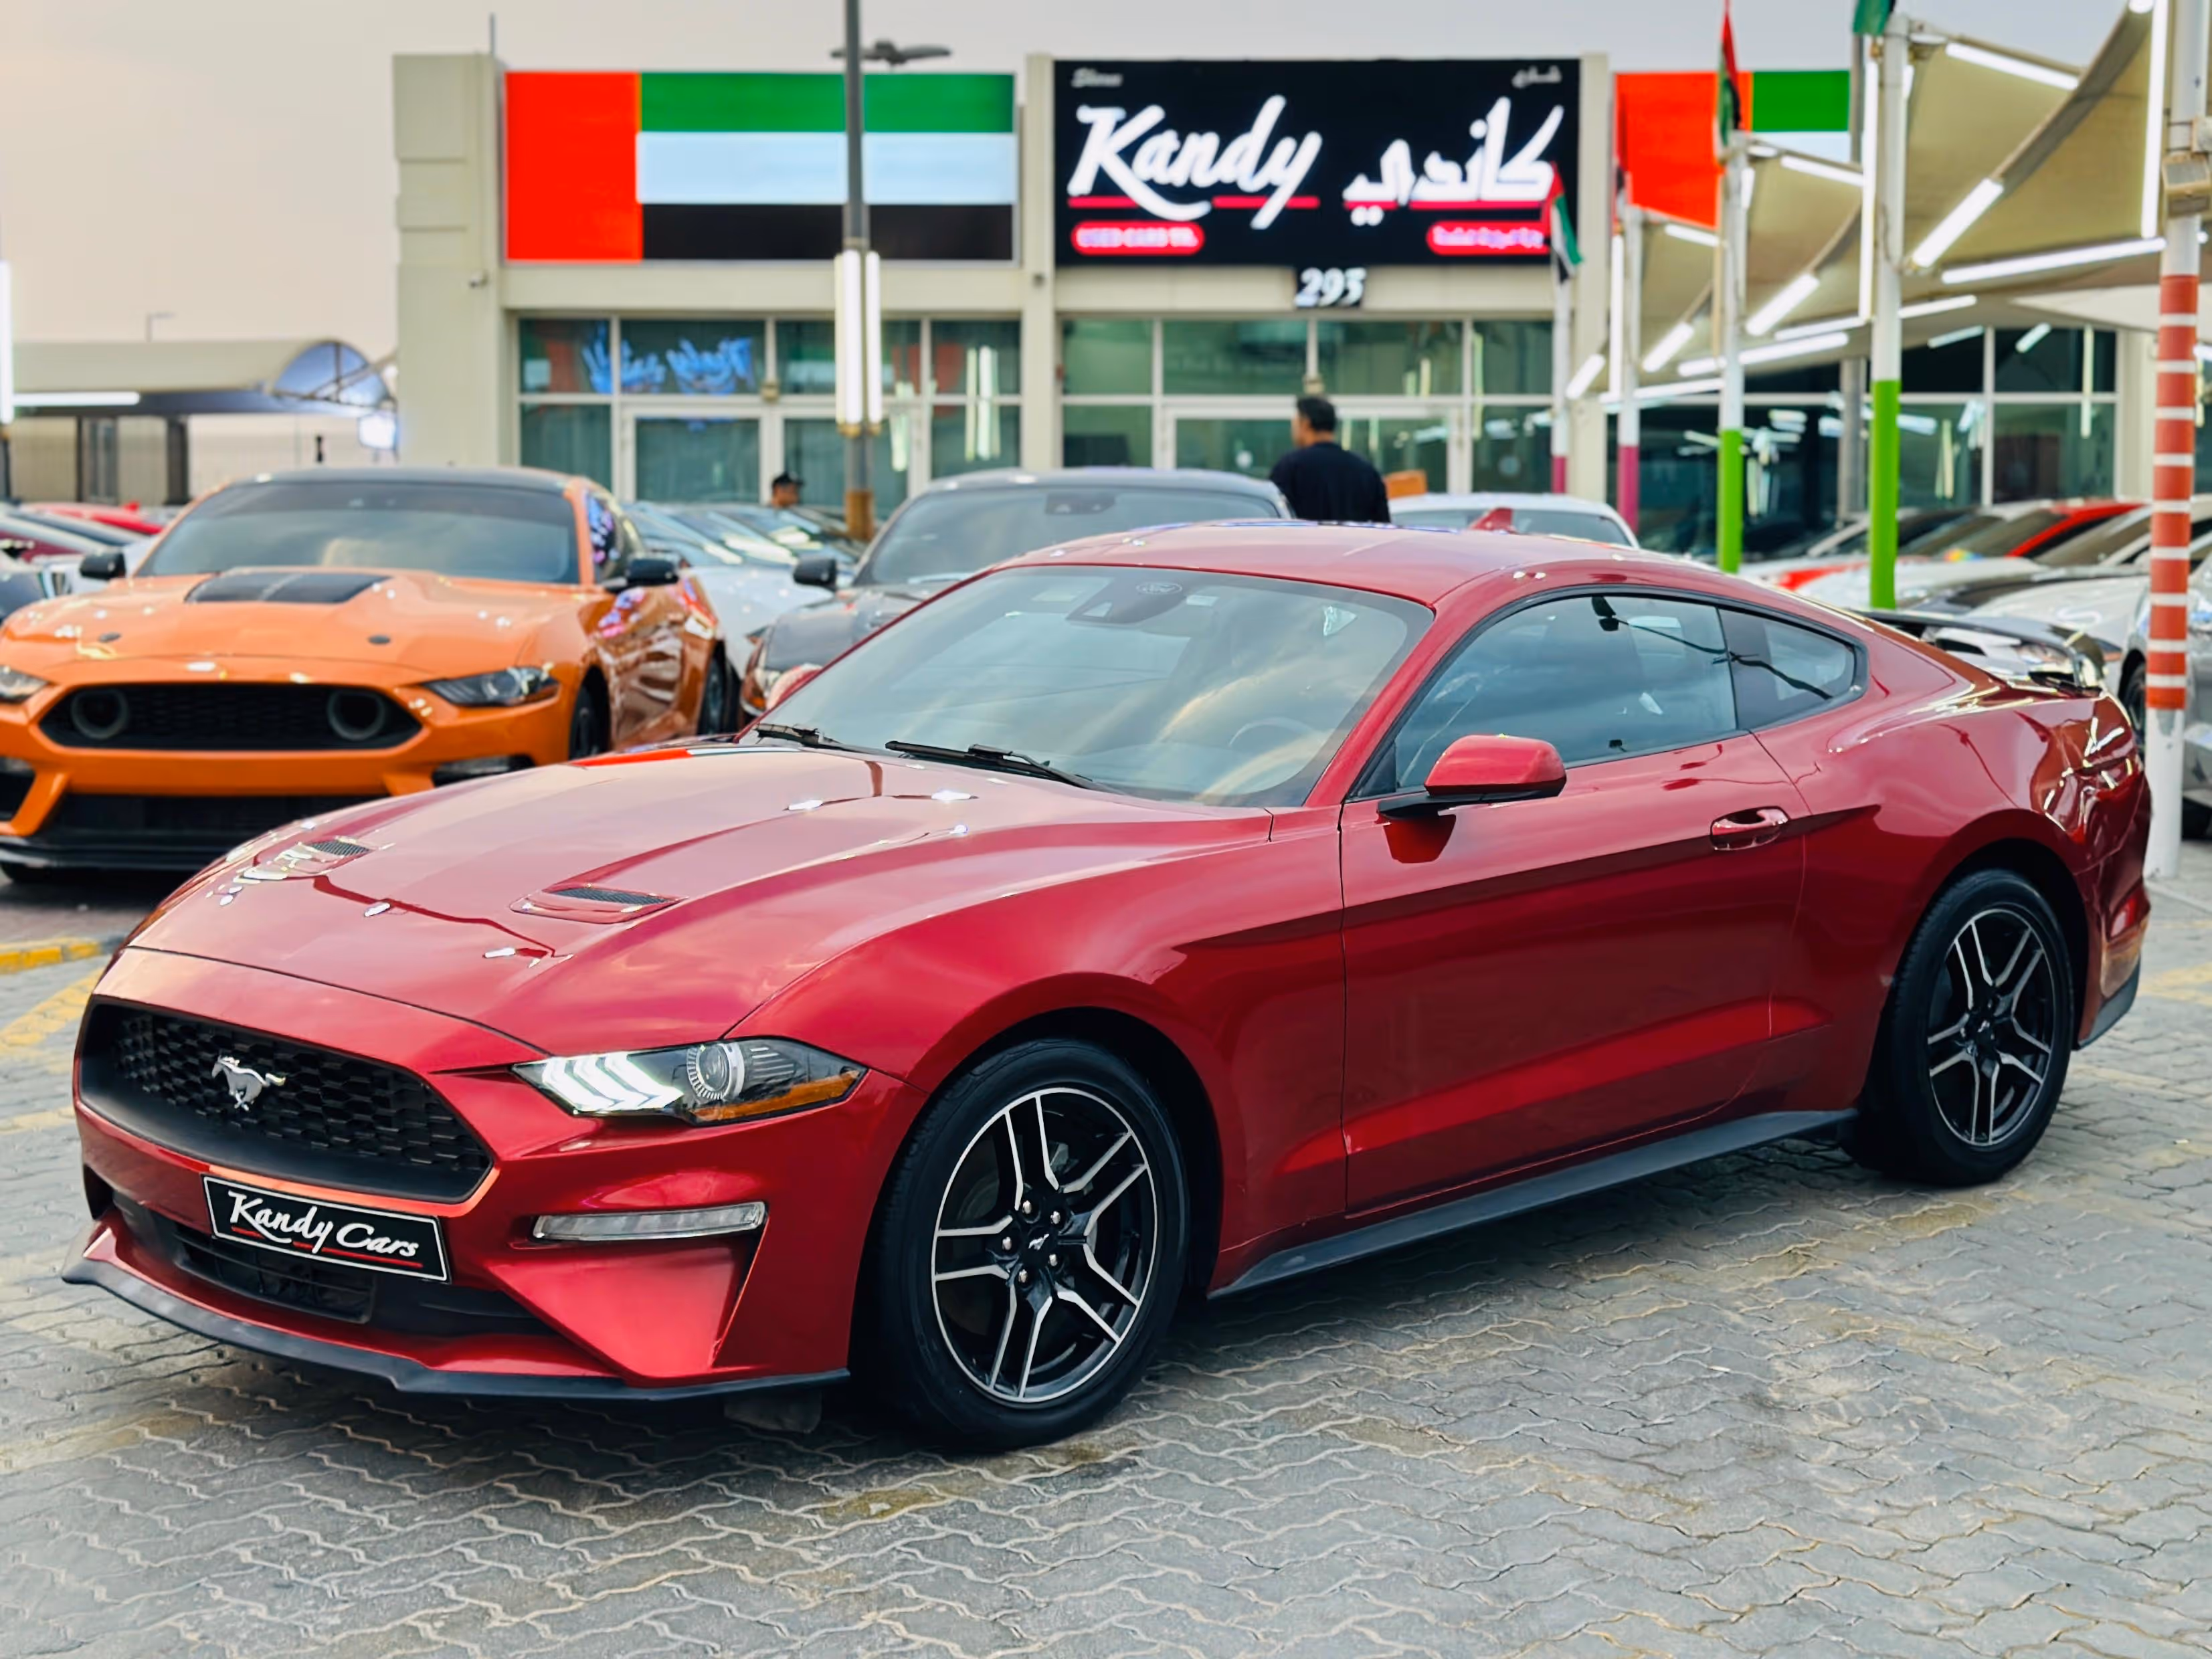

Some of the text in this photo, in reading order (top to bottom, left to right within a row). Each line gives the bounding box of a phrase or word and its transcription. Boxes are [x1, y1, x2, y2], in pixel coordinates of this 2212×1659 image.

[1068, 95, 1322, 229] Kandy
[1342, 97, 1564, 226] كاندي
[1295, 267, 1366, 306] 295
[228, 1191, 419, 1257] Kandy Cars
